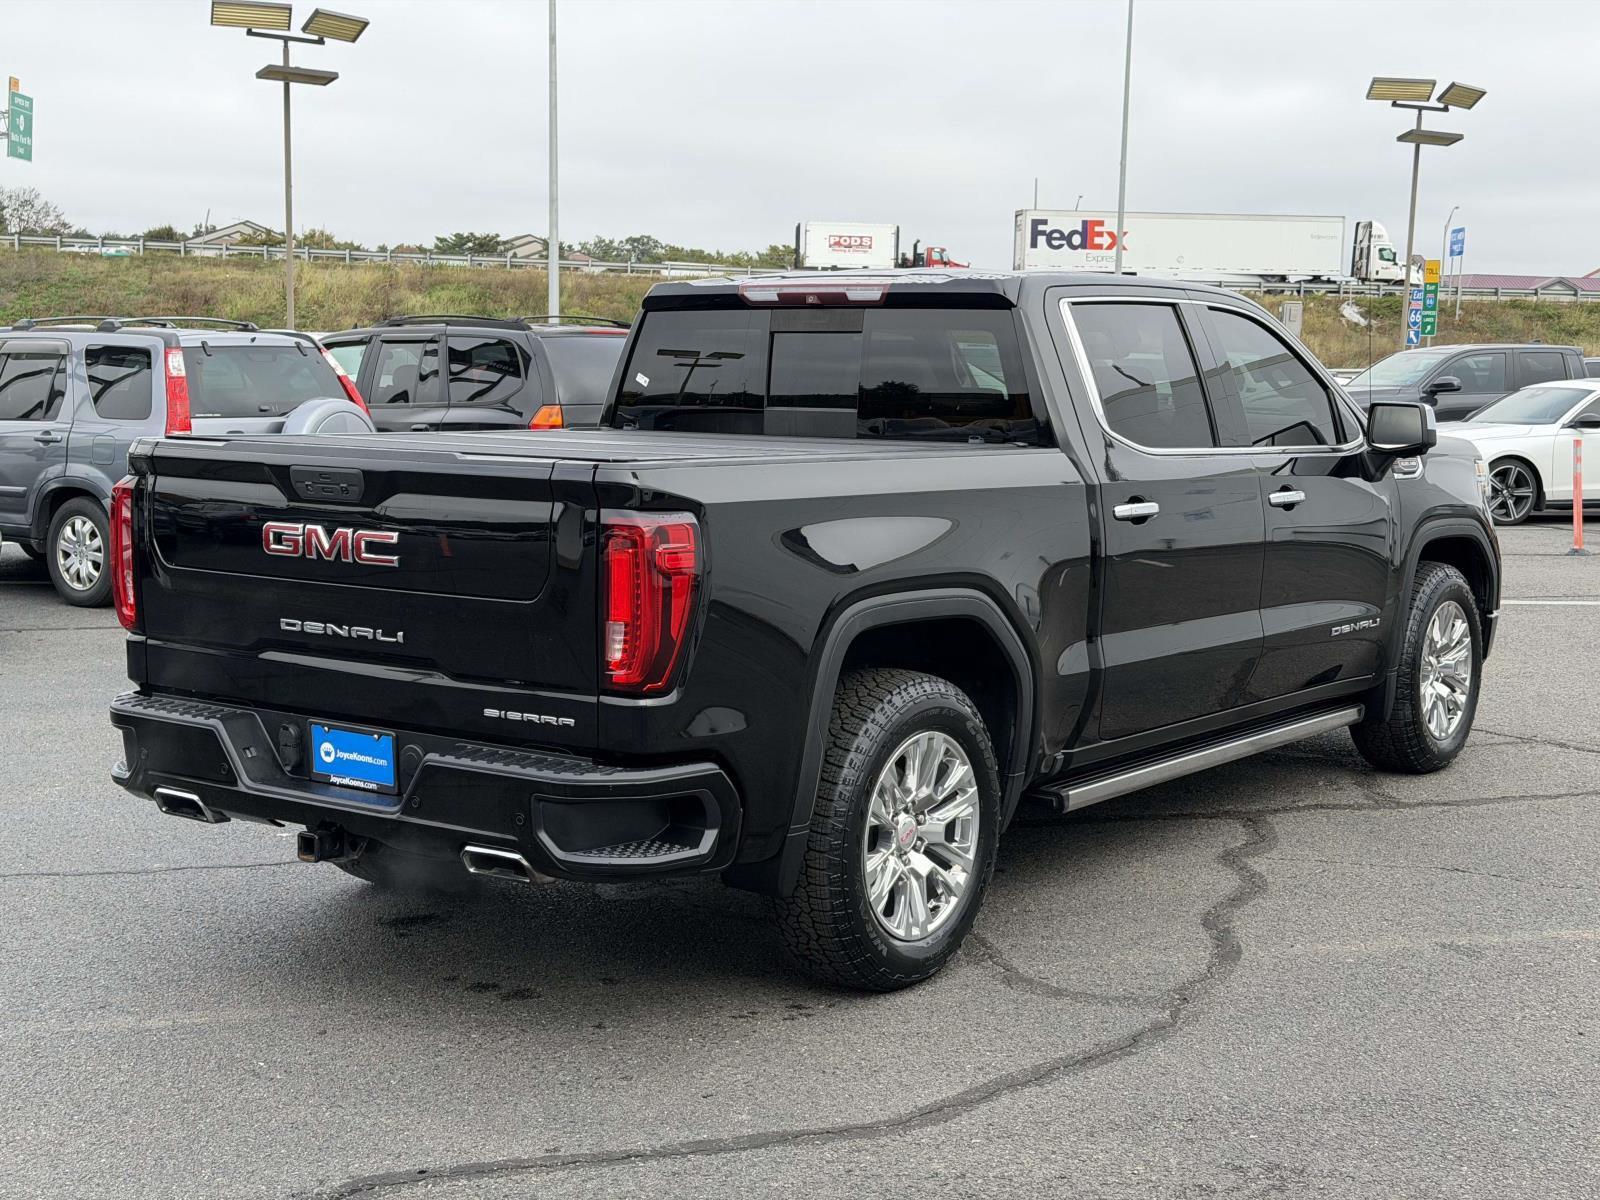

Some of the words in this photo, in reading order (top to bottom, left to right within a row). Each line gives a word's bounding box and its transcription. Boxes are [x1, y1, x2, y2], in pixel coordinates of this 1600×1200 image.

[829, 237, 871, 246] PODS
[1030, 218, 1128, 251] FedEx
[1086, 252, 1118, 264] Expres
[1426, 267, 1439, 275] TOLL
[1410, 310, 1421, 322] 66
[262, 521, 399, 567] GMC
[280, 618, 404, 643] DENALI
[1331, 618, 1380, 636] DENALI
[483, 708, 575, 727] SIERRA
[336, 749, 388, 767] JoyceKoons.com
[329, 774, 378, 790] JoyceKoons.com
